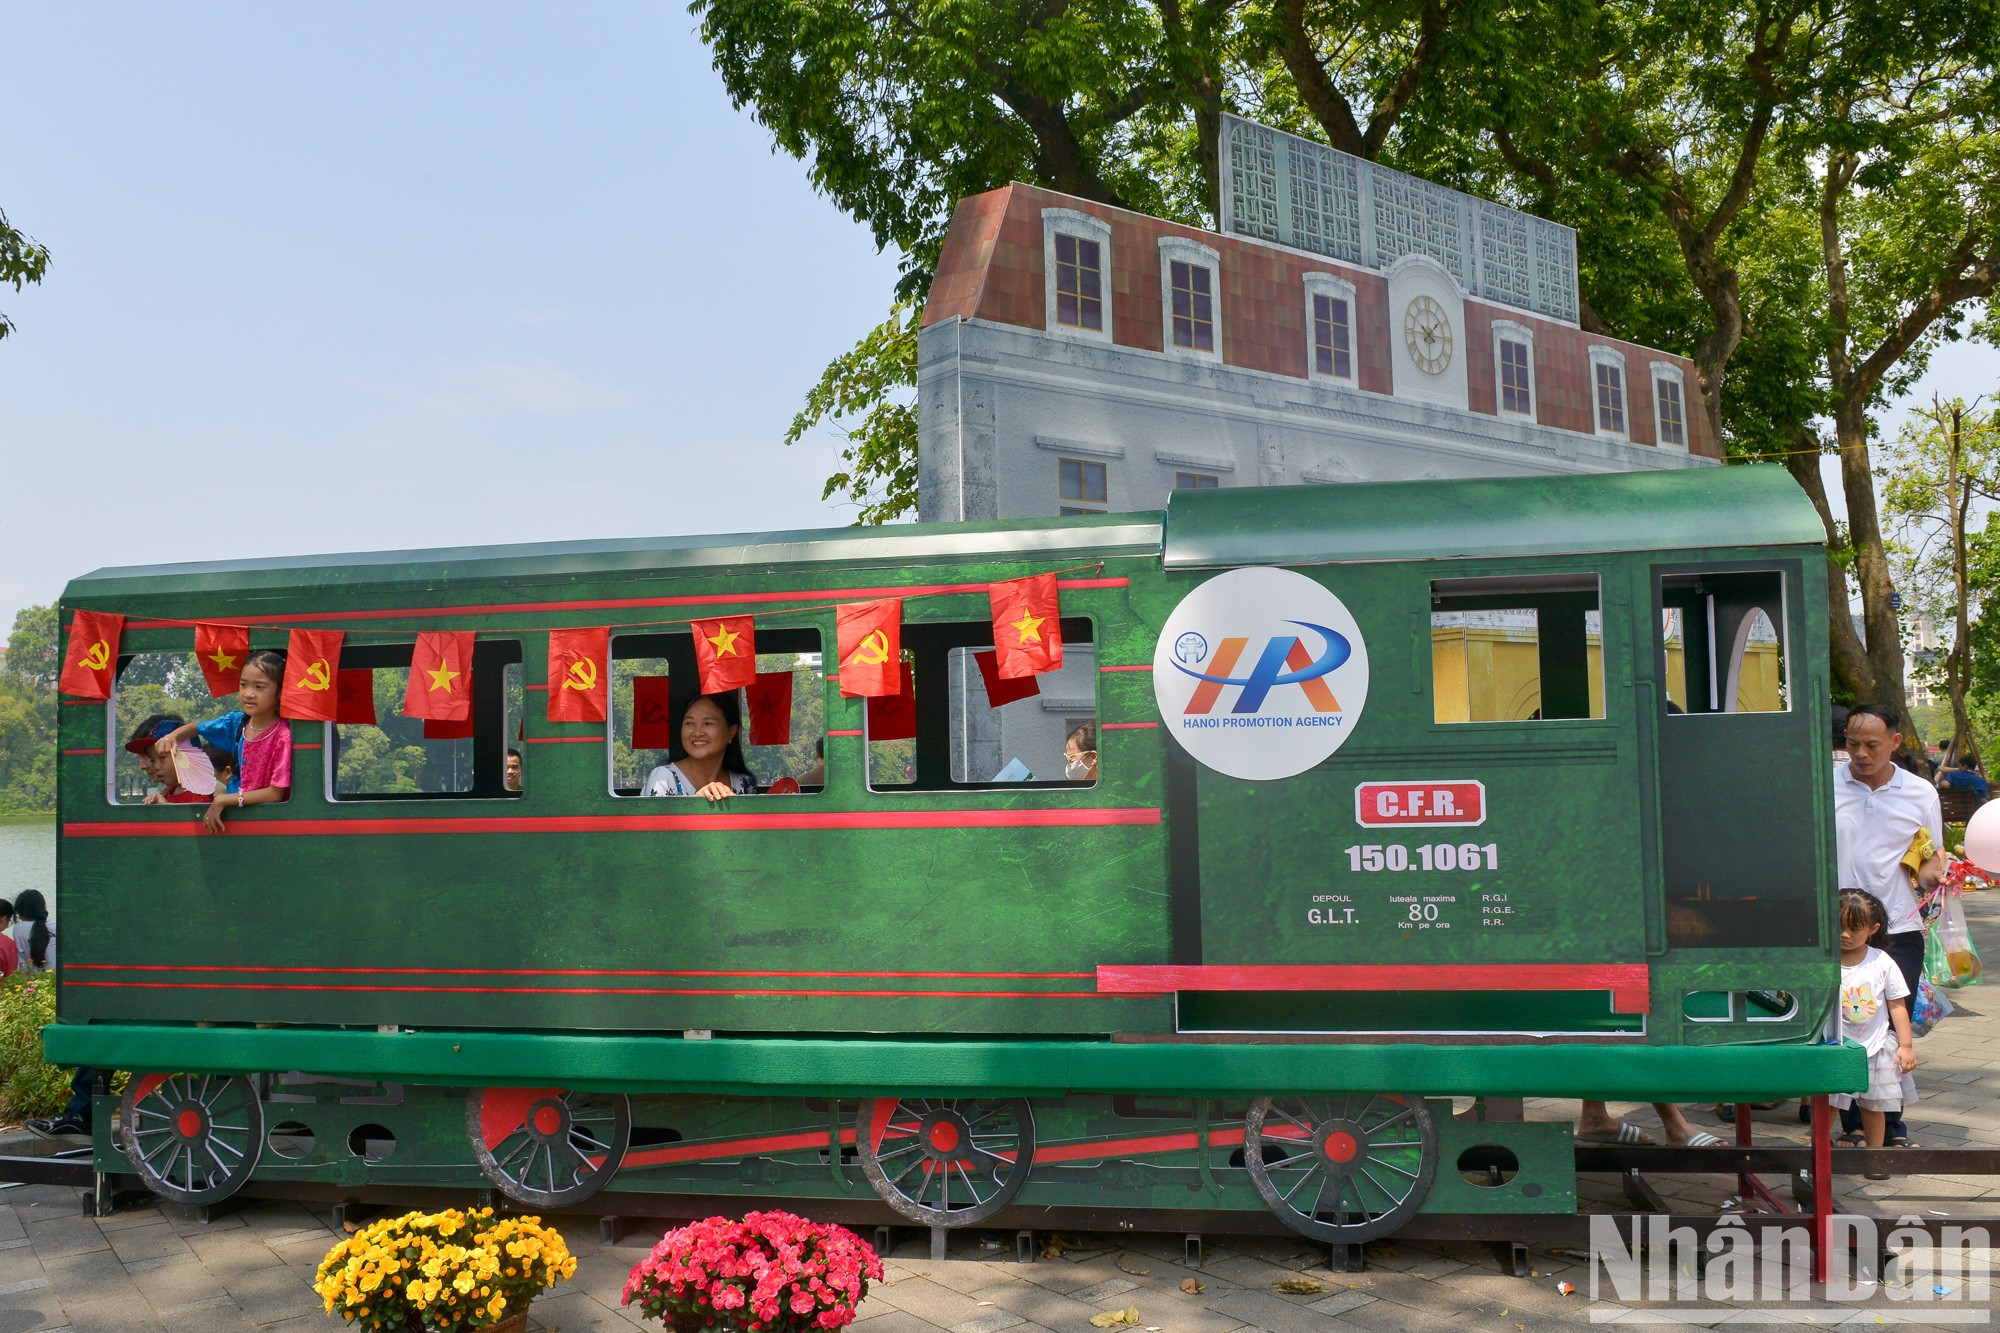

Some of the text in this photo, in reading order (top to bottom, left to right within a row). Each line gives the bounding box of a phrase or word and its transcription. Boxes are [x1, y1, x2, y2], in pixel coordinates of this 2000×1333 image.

[1183, 716, 1343, 728] HANOI PROMOTION AGENCY
[1376, 790, 1464, 817] C.F.R.
[1344, 843, 1498, 871] 150.1061
[1482, 894, 1507, 902] R.G.I
[1307, 908, 1360, 924] G.L.T.
[1408, 904, 1439, 921] 80
[1482, 906, 1515, 914] R.G.E.
[1418, 922, 1430, 930] pe
[1483, 918, 1505, 926] R.R.
